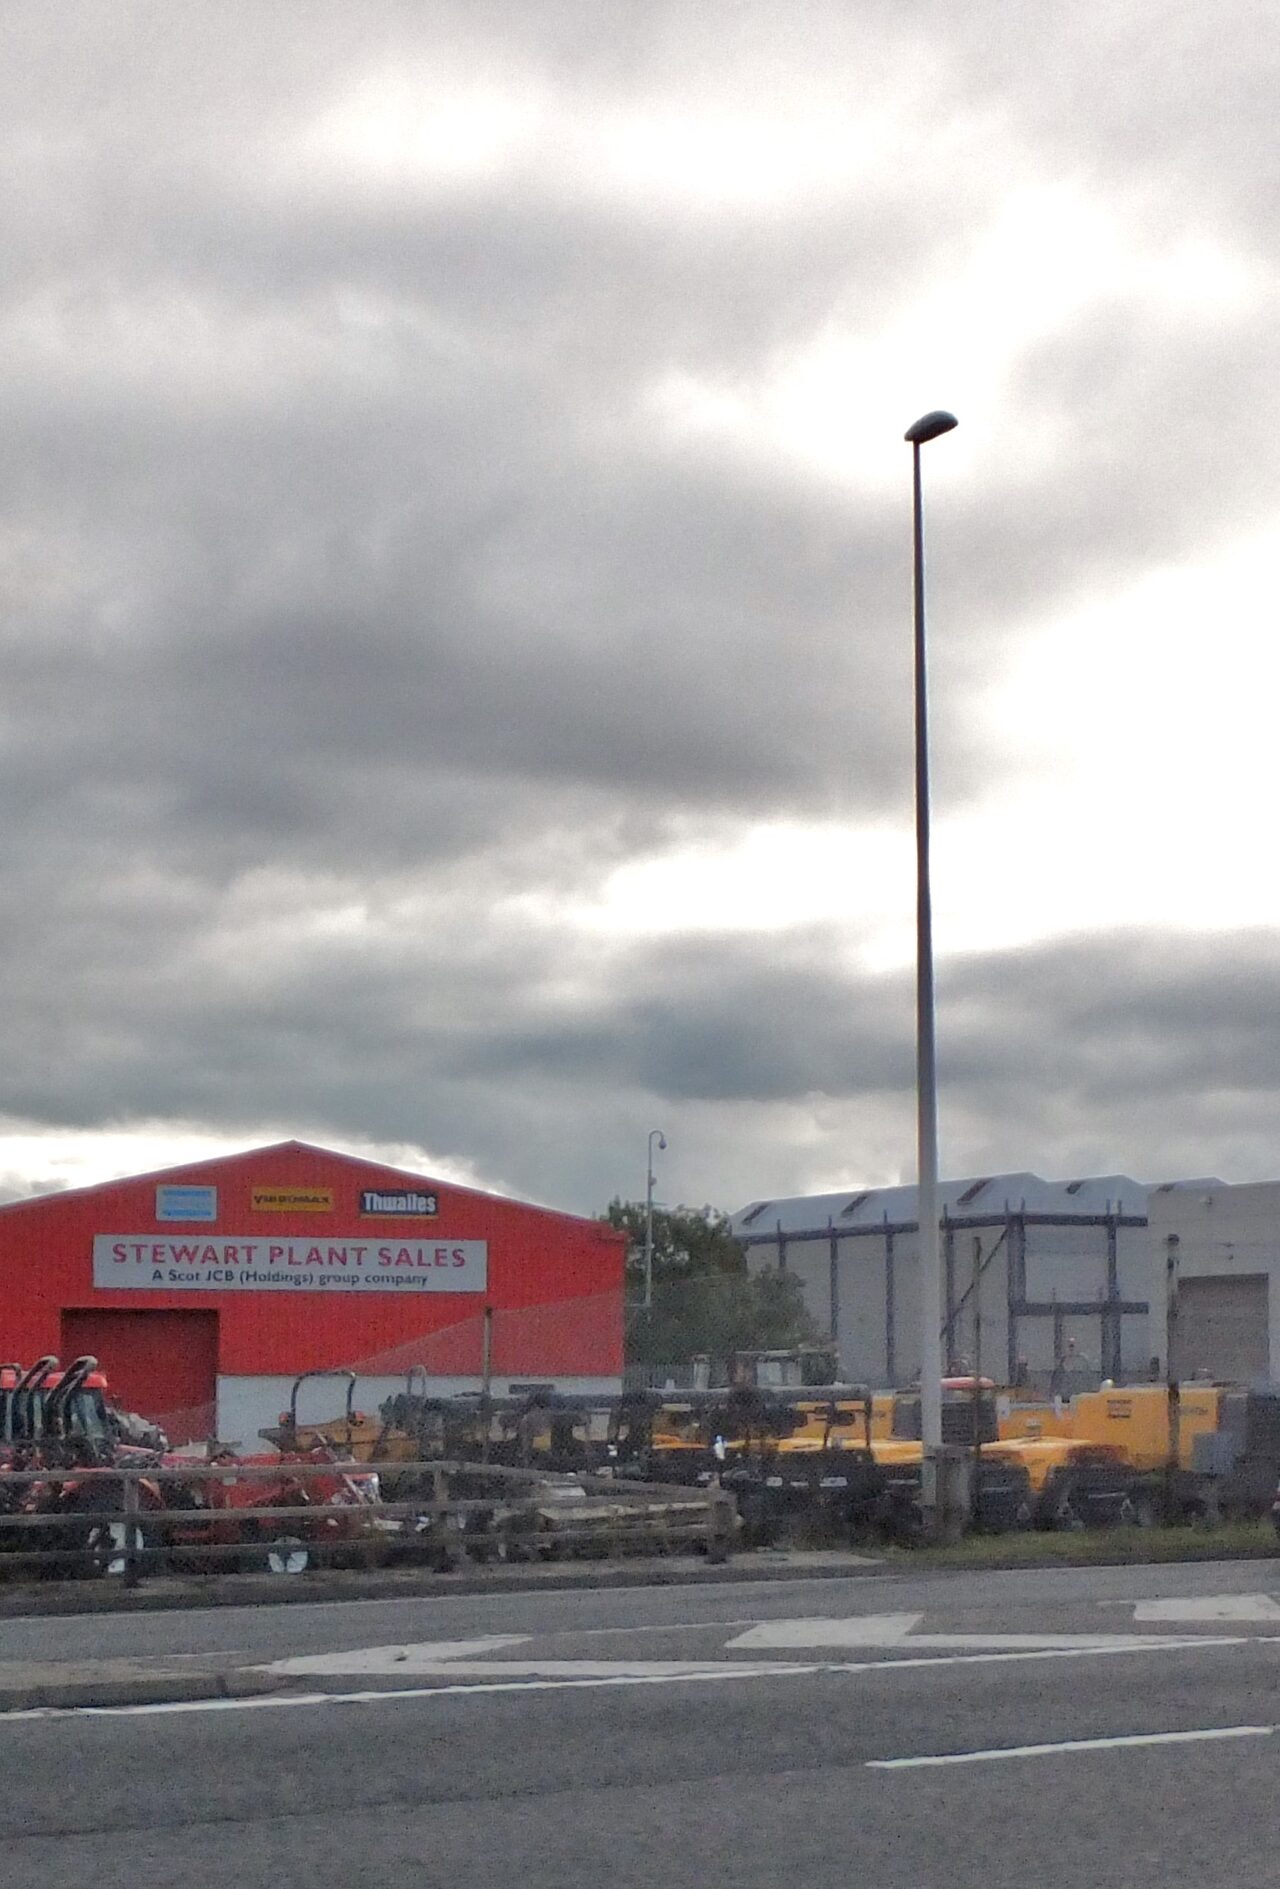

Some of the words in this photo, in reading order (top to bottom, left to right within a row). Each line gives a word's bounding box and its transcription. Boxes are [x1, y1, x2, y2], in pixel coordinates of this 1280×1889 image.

[112, 1243, 257, 1264] STEWART
[269, 1246, 367, 1266] PLANT
[377, 1247, 466, 1267] SALES
[152, 1269, 163, 1281] A
[168, 1270, 200, 1281] Scot
[205, 1270, 234, 1282] JCB
[240, 1271, 314, 1286] (Holdings)
[319, 1275, 360, 1286] group
[365, 1275, 428, 1287] company
